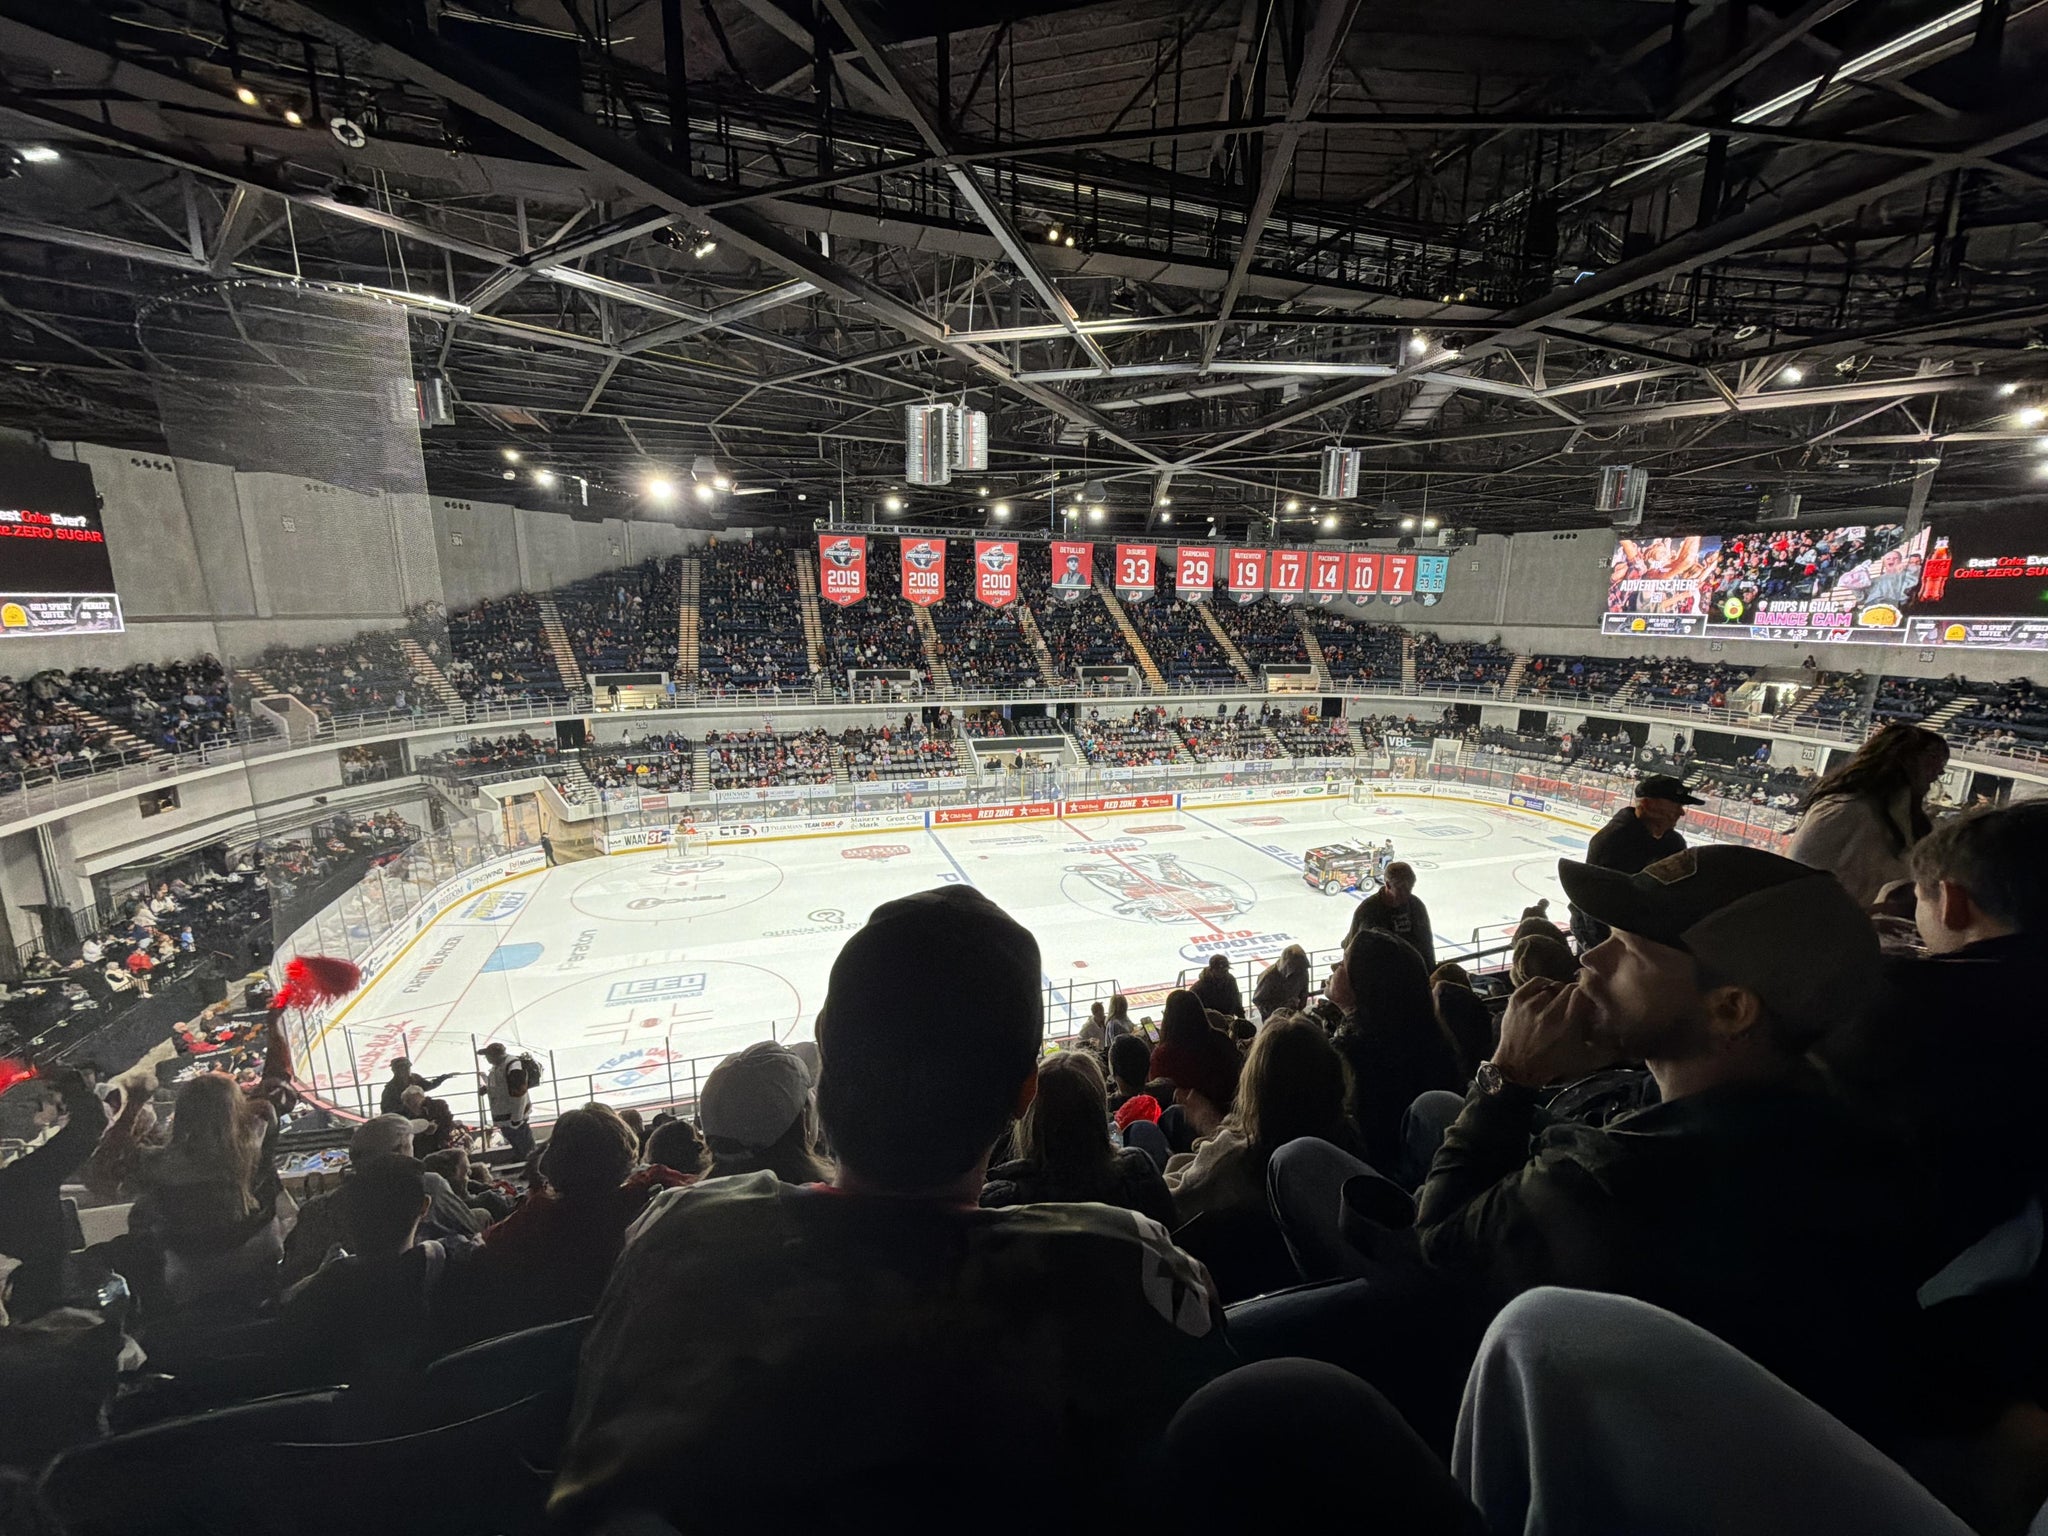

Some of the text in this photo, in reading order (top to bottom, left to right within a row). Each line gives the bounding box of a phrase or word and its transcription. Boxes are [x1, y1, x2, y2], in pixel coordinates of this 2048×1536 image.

[21, 510, 52, 524] Coke
[52, 513, 86, 527] Ever?
[13, 525, 54, 539] ZERO
[56, 529, 104, 542] SUGAR
[1968, 558, 1998, 568] Best
[1998, 557, 2026, 566] Coke
[828, 570, 860, 585] 2019
[1122, 558, 1150, 584] 33
[1182, 560, 1208, 584] 29
[1236, 563, 1257, 586] 19
[1279, 564, 1298, 586] 17
[1318, 564, 1336, 588] 14
[1354, 566, 1372, 588] 10
[1393, 567, 1404, 589] 7
[1954, 568, 1984, 578] Coke
[1986, 568, 2024, 578] ZERO
[909, 572, 939, 586] 2018
[982, 574, 1010, 588] 2010
[1620, 579, 1699, 591] ADVERTISE HERE
[1770, 601, 1839, 612] HOPS N GUAC
[1754, 612, 1852, 626] DANCE CAM
[1684, 625, 1691, 634] 9
[1774, 630, 1782, 638] 2
[1816, 630, 1822, 639] 1
[1919, 632, 1928, 641] 7
[1388, 736, 1412, 748] VBC
[1802, 751, 1815, 760] 213
[1103, 800, 1138, 809] RED ZONE
[906, 814, 922, 822] Clips
[978, 808, 1014, 818] RED ZONE
[720, 825, 752, 836] CTS
[624, 831, 662, 846] WAAY 31
[472, 868, 504, 886] PINGWIND
[762, 927, 817, 936] QUINN
[1194, 933, 1290, 952] ROOTER
[402, 970, 434, 994] FARM
[604, 997, 658, 1008] CORPORATE
[596, 1048, 644, 1070] TEAM
